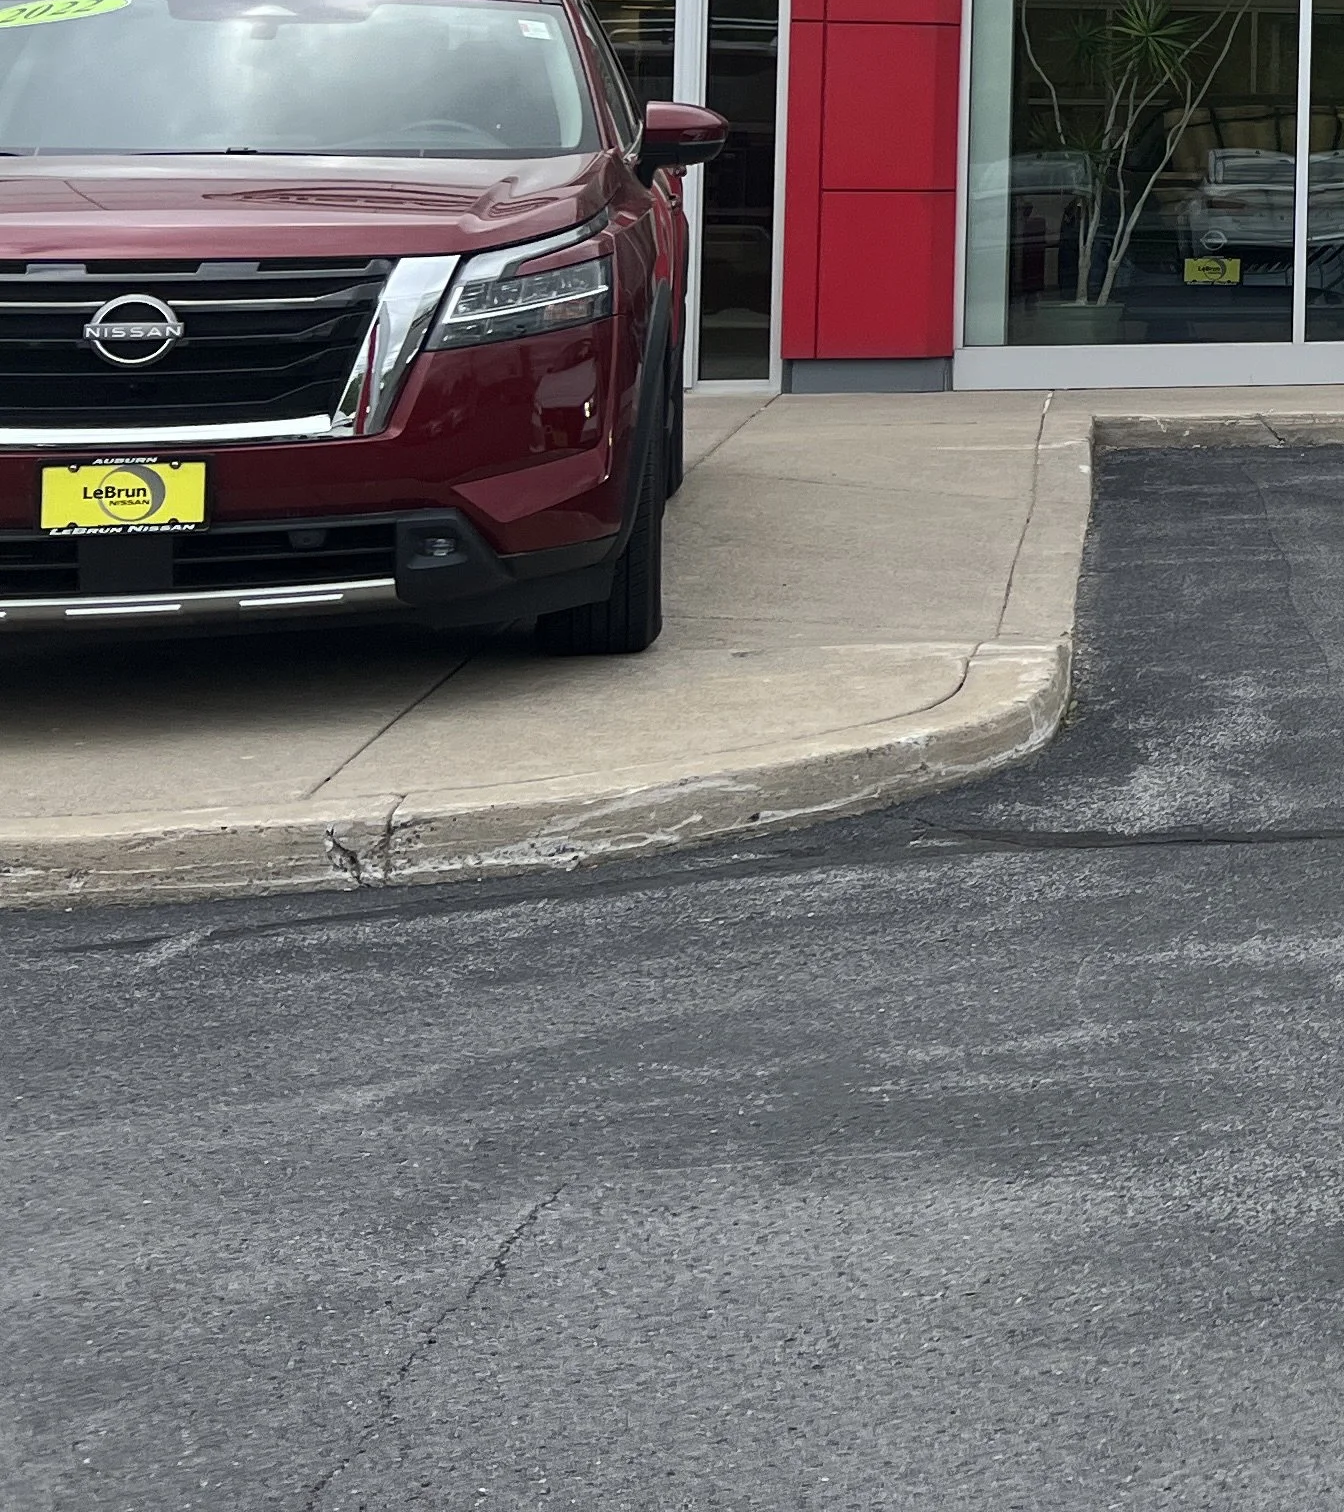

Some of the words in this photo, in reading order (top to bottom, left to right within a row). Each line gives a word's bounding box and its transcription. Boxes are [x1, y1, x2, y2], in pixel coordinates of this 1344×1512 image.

[85, 326, 181, 339] NISSAN
[92, 456, 159, 466] AUBURN
[83, 486, 148, 500] LeBrun
